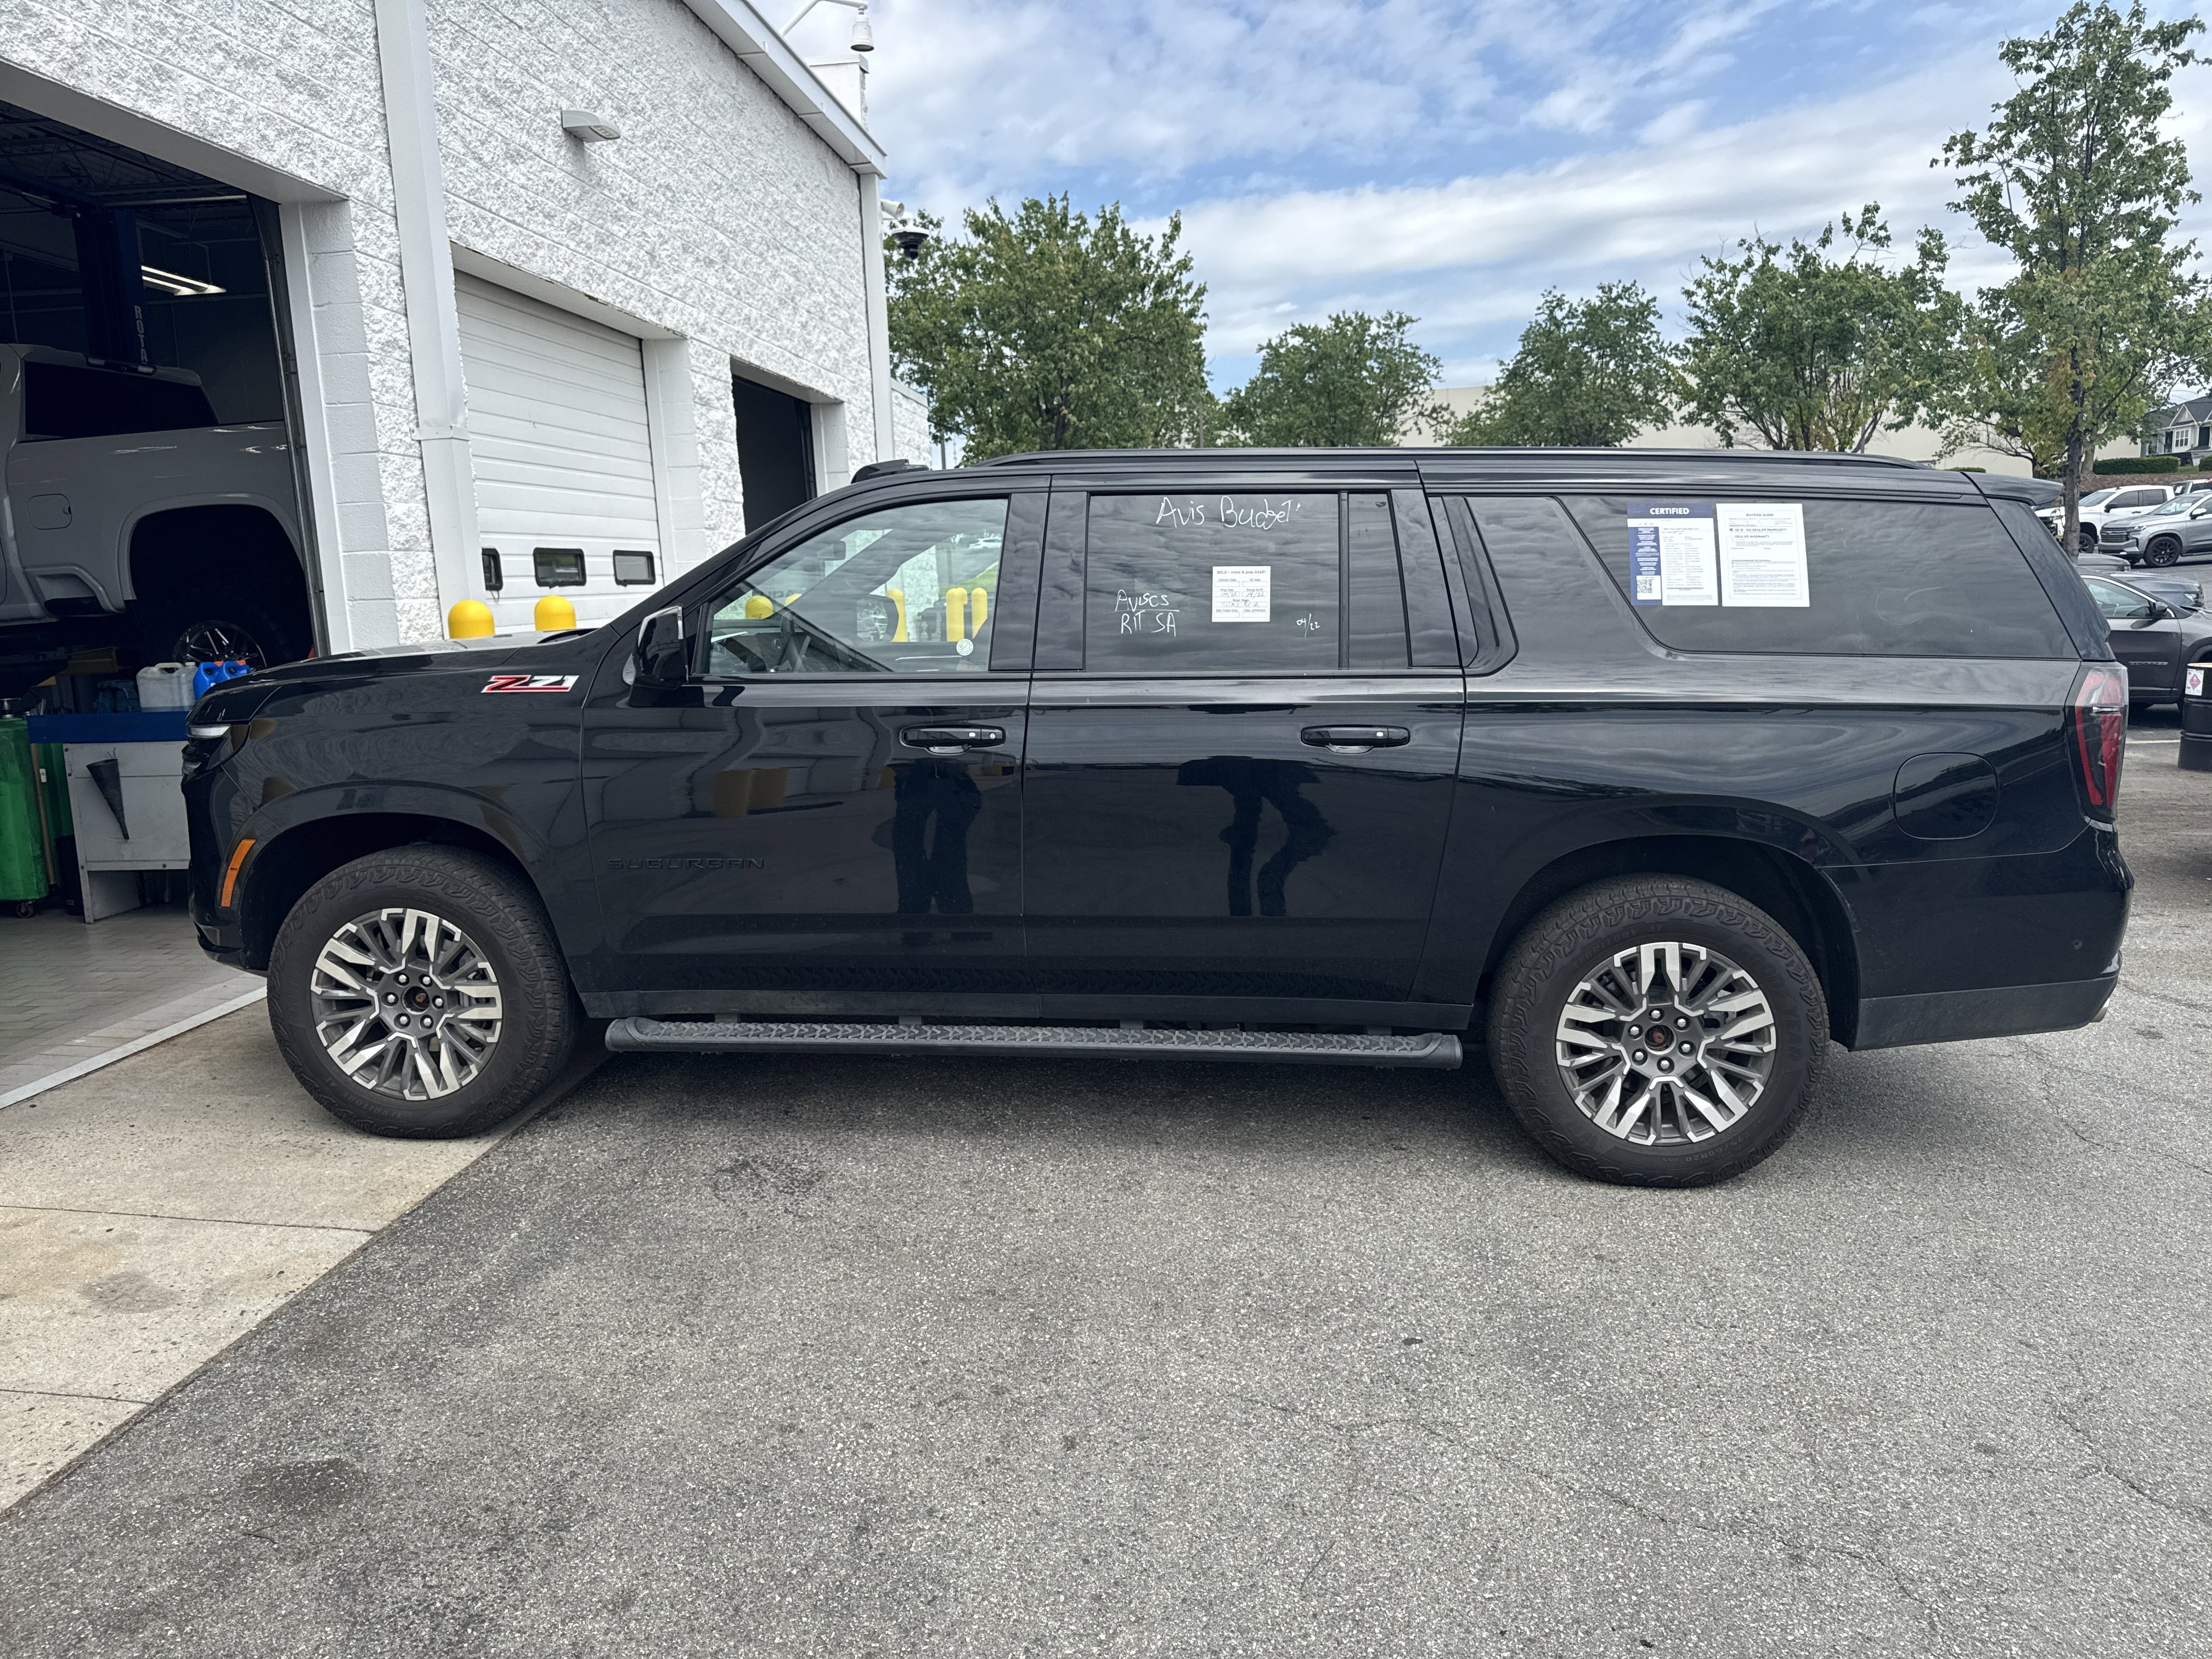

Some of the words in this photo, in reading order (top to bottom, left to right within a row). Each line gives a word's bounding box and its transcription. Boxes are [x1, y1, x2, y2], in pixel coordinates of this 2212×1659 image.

[134, 305, 149, 365] ROTA
[1156, 496, 1205, 528] Avis
[1151, 612, 1176, 637] SA
[1296, 613, 1321, 638] 04/22
[481, 675, 580, 693] Z71
[606, 857, 765, 870] SUBURBAN
[1573, 928, 1638, 969] TERRITORY
[1647, 923, 1663, 932] AT
